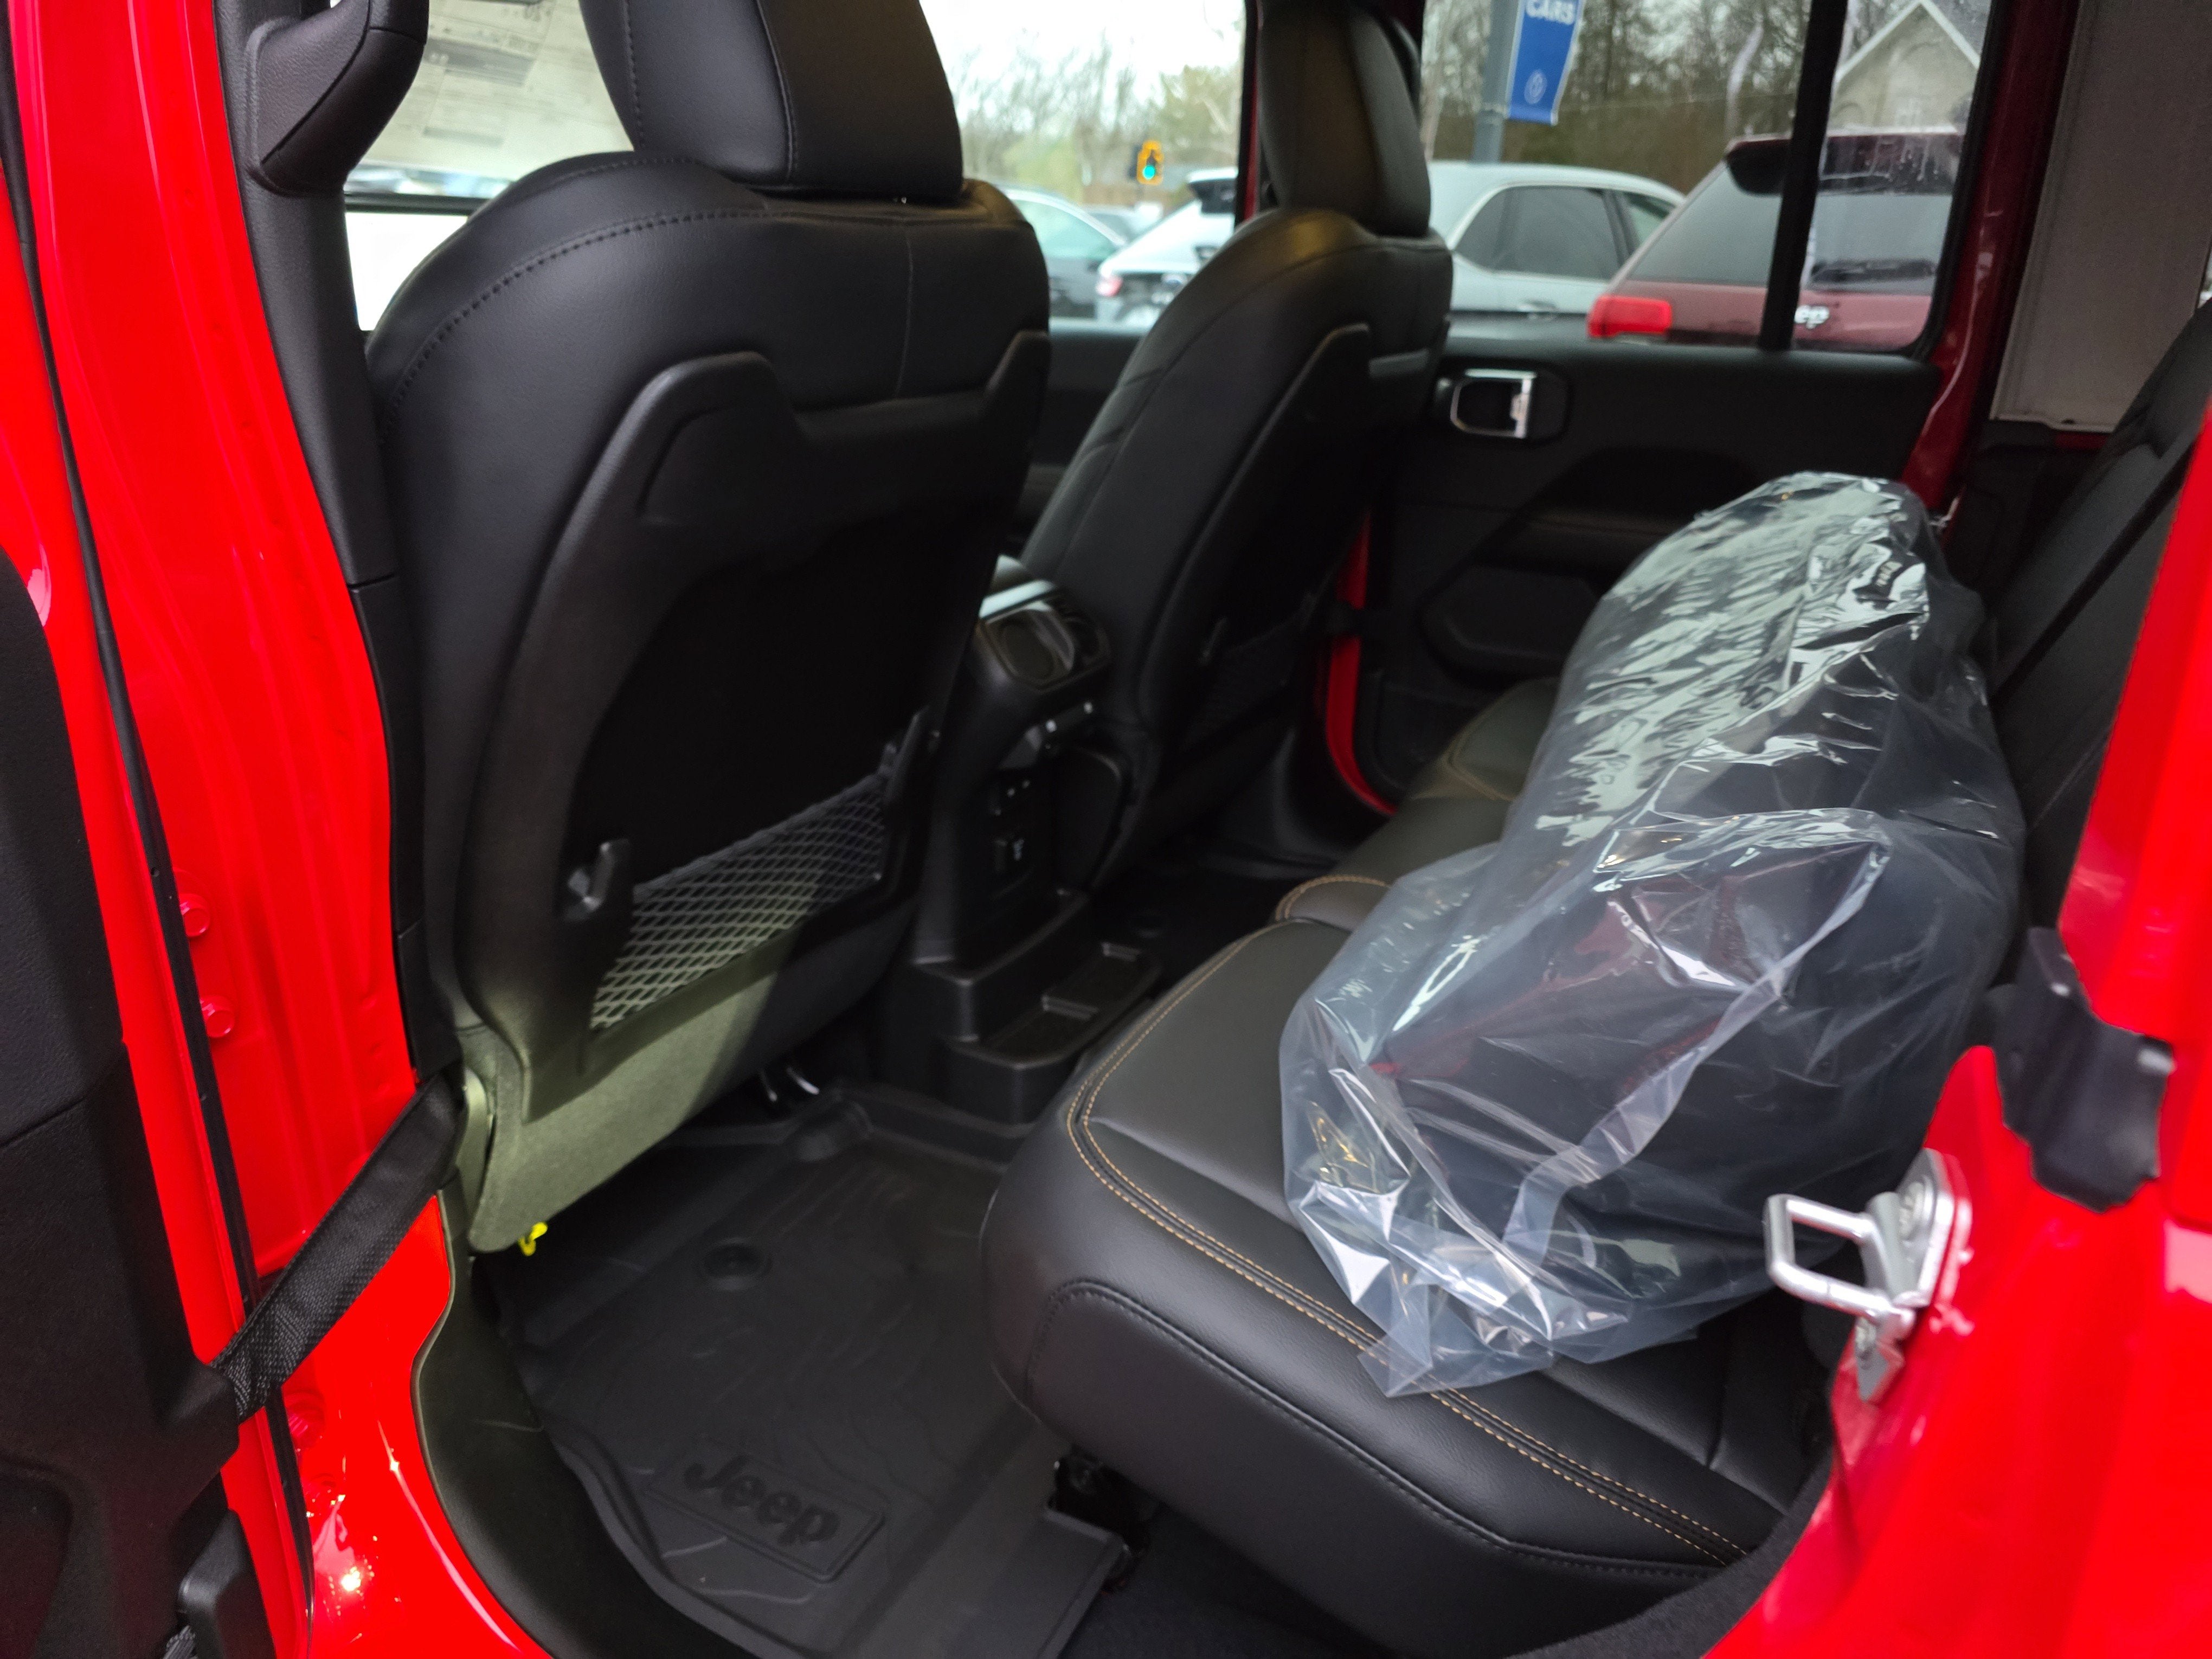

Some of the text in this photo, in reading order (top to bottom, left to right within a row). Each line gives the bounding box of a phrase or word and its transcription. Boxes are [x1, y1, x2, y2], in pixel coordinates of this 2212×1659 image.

[1526, 0, 1574, 25] CARS
[1794, 305, 1829, 329] ep
[684, 1455, 839, 1545] Jeep
